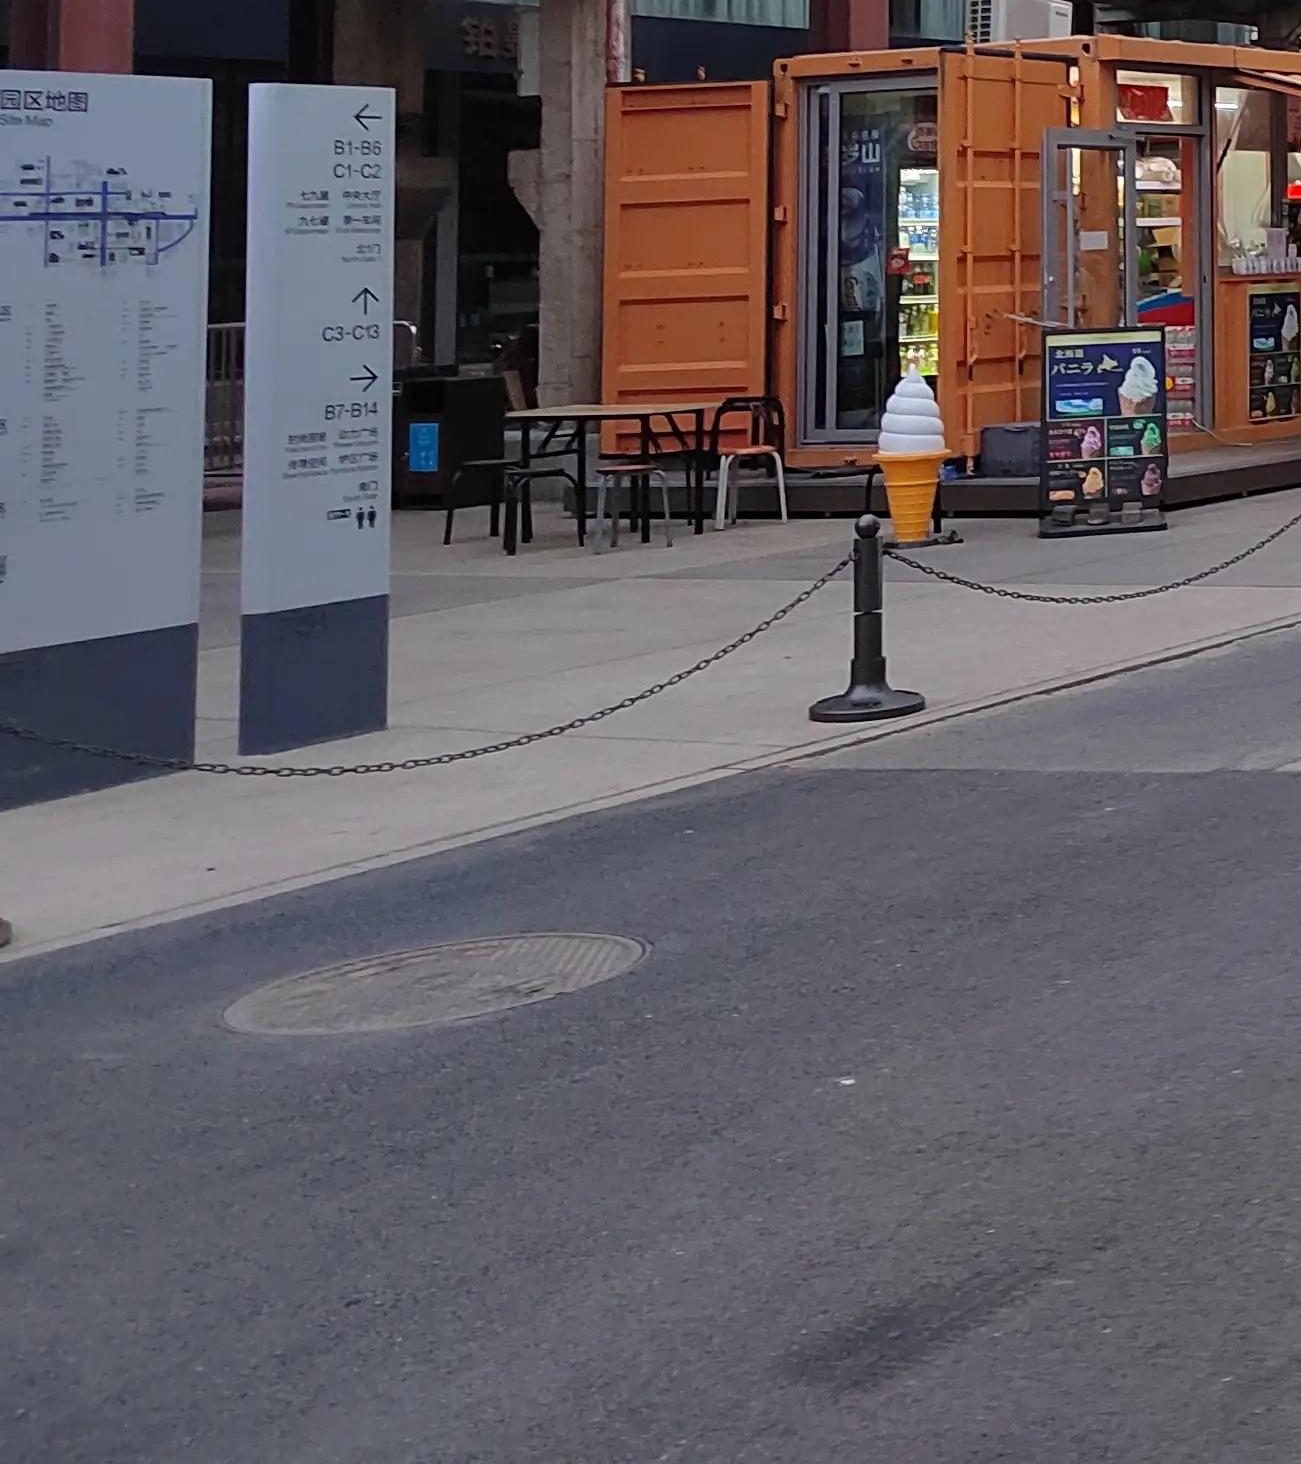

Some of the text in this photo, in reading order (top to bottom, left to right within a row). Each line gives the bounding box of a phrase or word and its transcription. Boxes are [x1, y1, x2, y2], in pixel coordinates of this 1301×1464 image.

[0, 90, 89, 112] 园区地图
[334, 140, 382, 155] B1-B6
[333, 163, 382, 179] C1-C2
[322, 324, 380, 342] C3-C13
[324, 402, 378, 421] B7-B14
